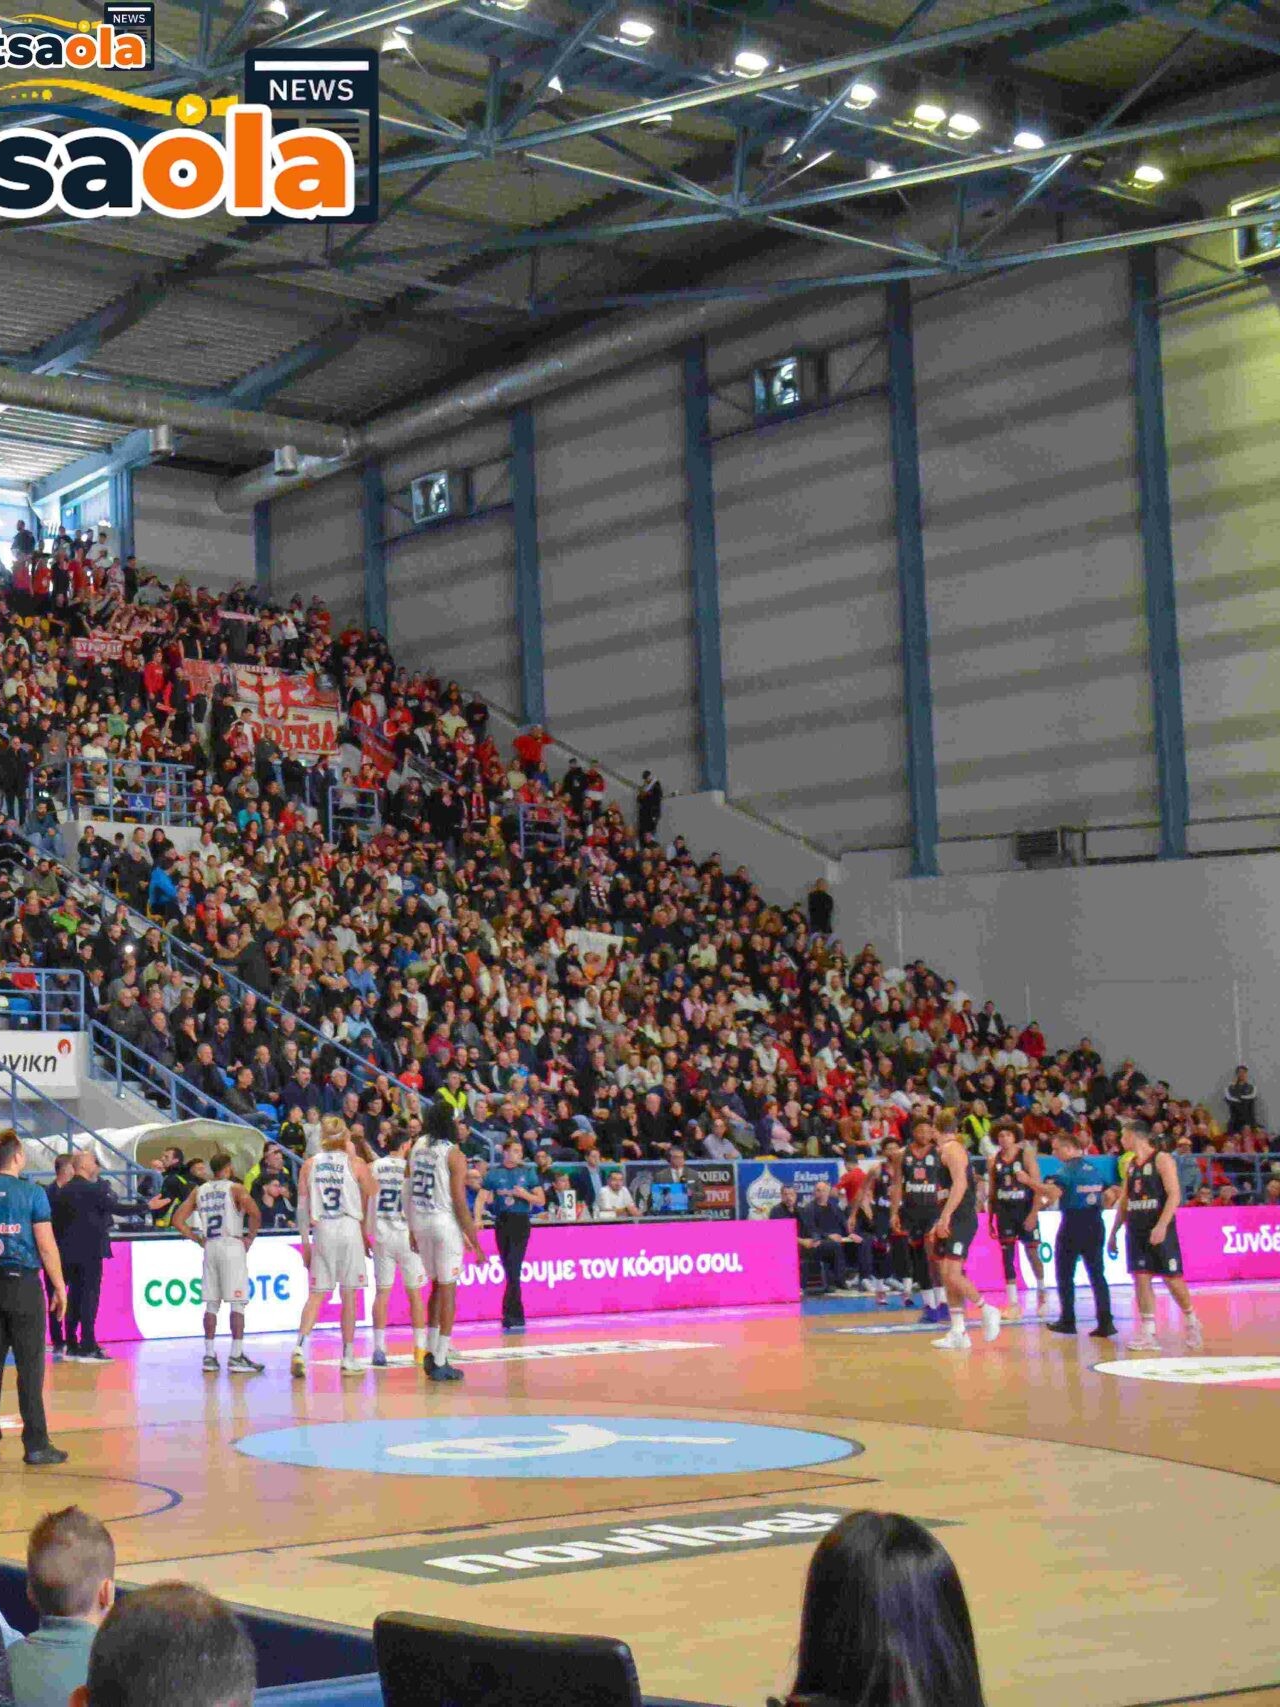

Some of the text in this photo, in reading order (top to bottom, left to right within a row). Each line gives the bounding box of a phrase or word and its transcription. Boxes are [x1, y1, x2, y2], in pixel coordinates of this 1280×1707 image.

[323, 1187, 341, 1211] 3
[905, 1180, 935, 1193] bwin
[206, 1215, 223, 1238] 2
[456, 1249, 744, 1289] υνδουμε τον κόσμο σου.
[144, 1274, 290, 1307] COSTE
[423, 1511, 841, 1575] novibet
